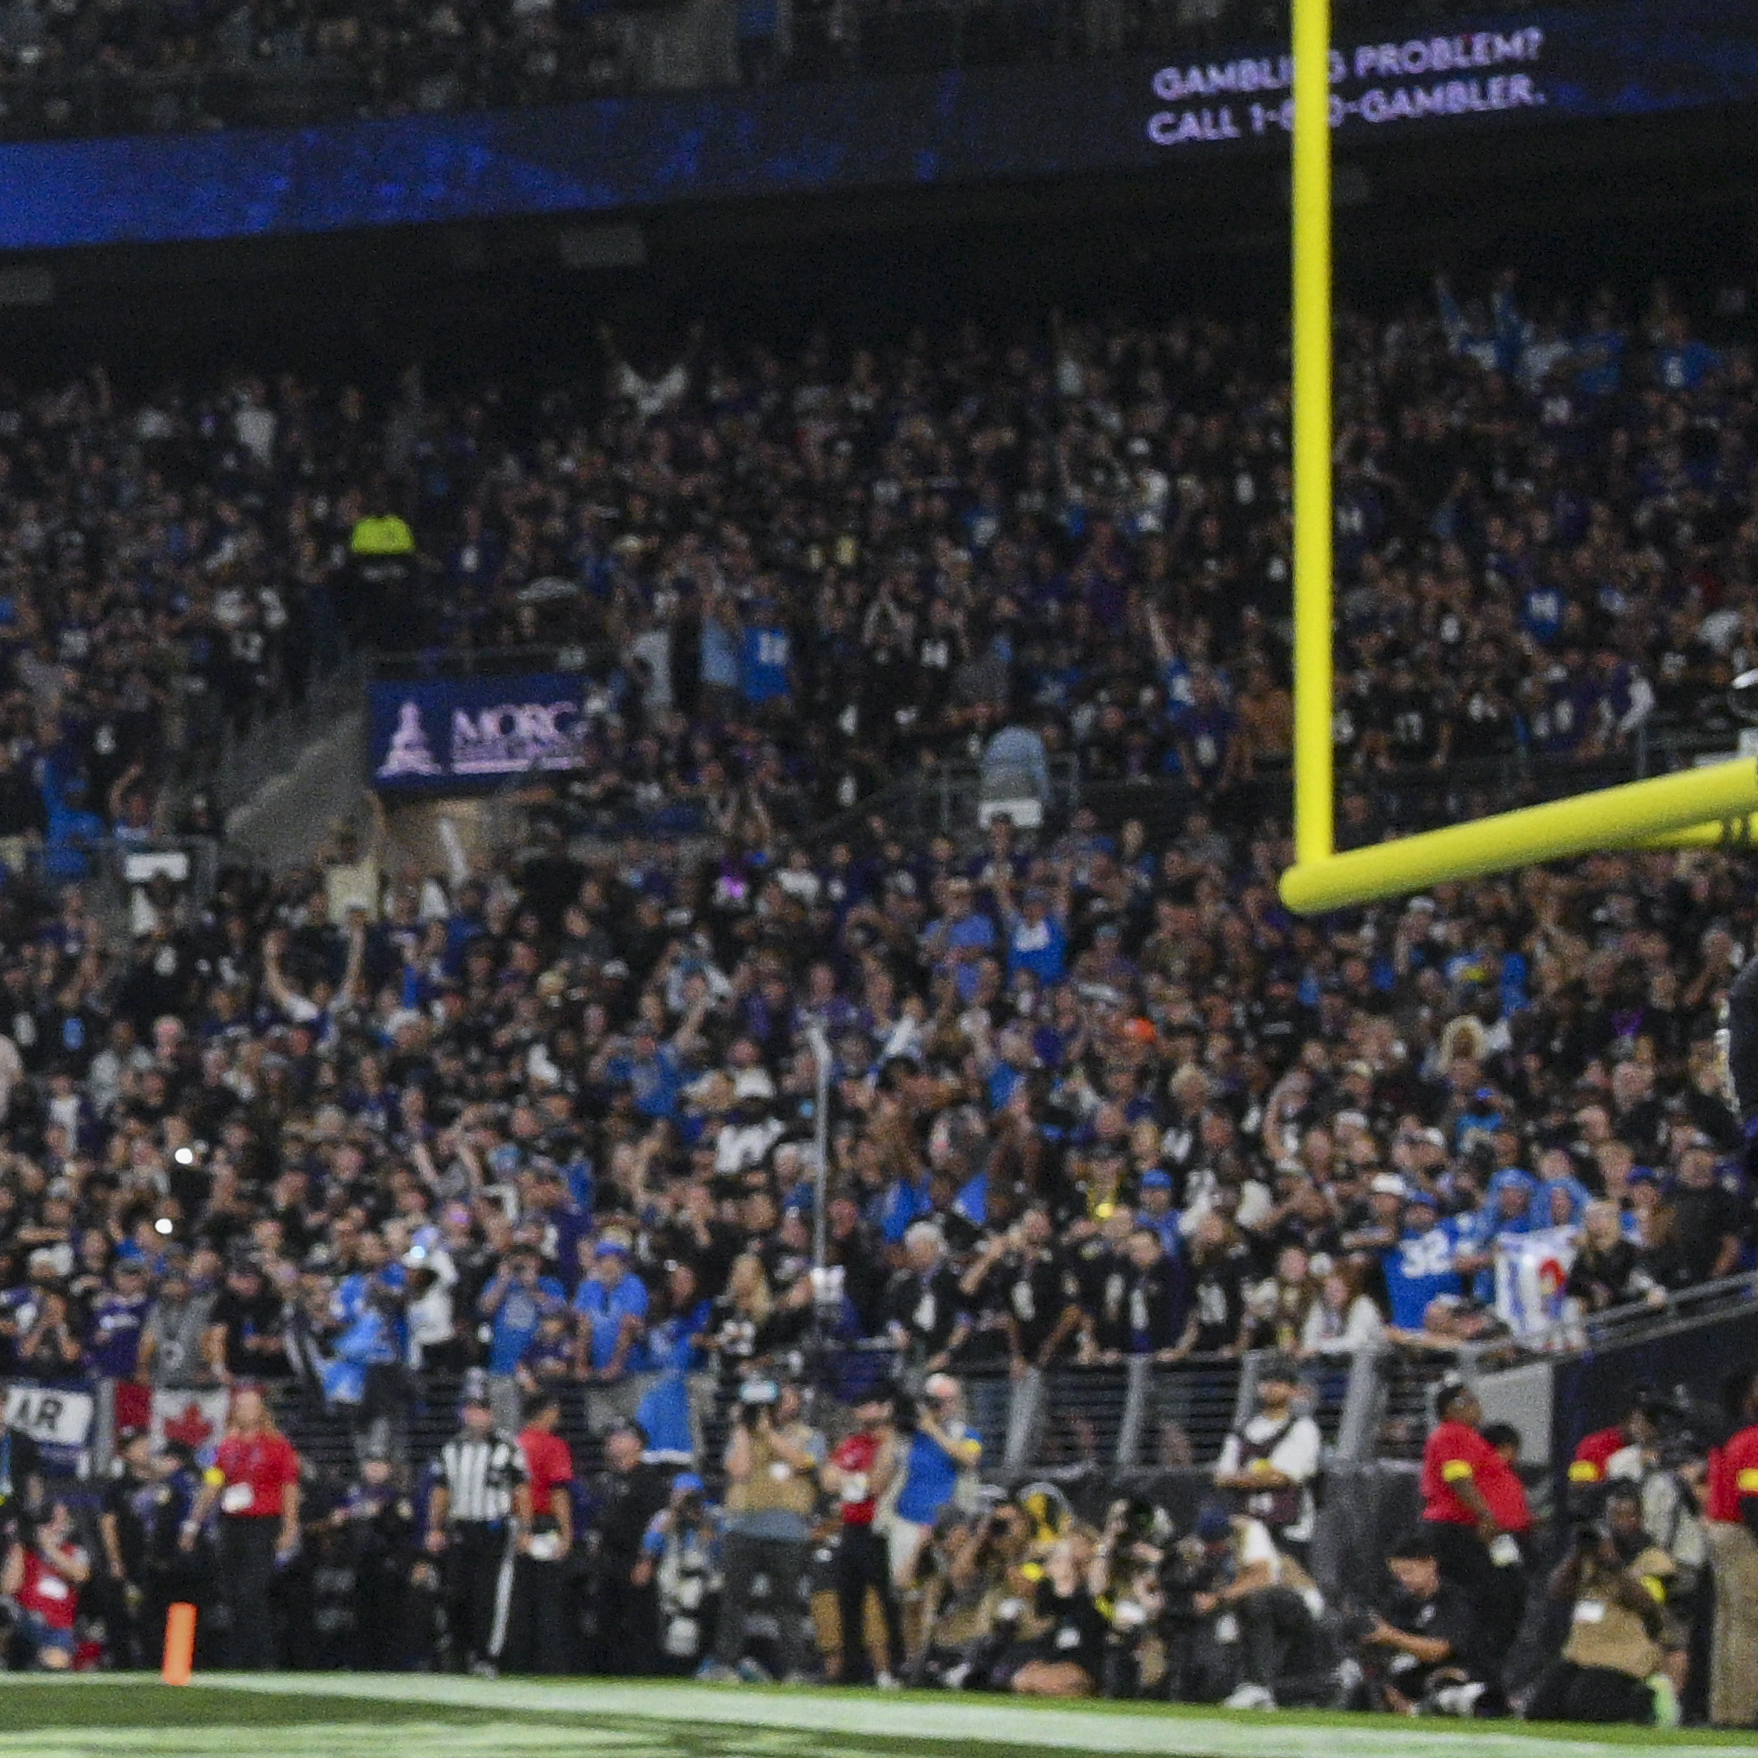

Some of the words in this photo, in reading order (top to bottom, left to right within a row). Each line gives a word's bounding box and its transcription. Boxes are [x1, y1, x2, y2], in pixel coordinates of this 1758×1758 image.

[1152, 50, 1347, 99] GAMBLIG
[1355, 27, 1545, 75] PROBLEM?
[1147, 105, 1240, 145] CALL
[1251, 74, 1547, 136] 1-80-GAMBLER.
[451, 701, 580, 742] MORG
